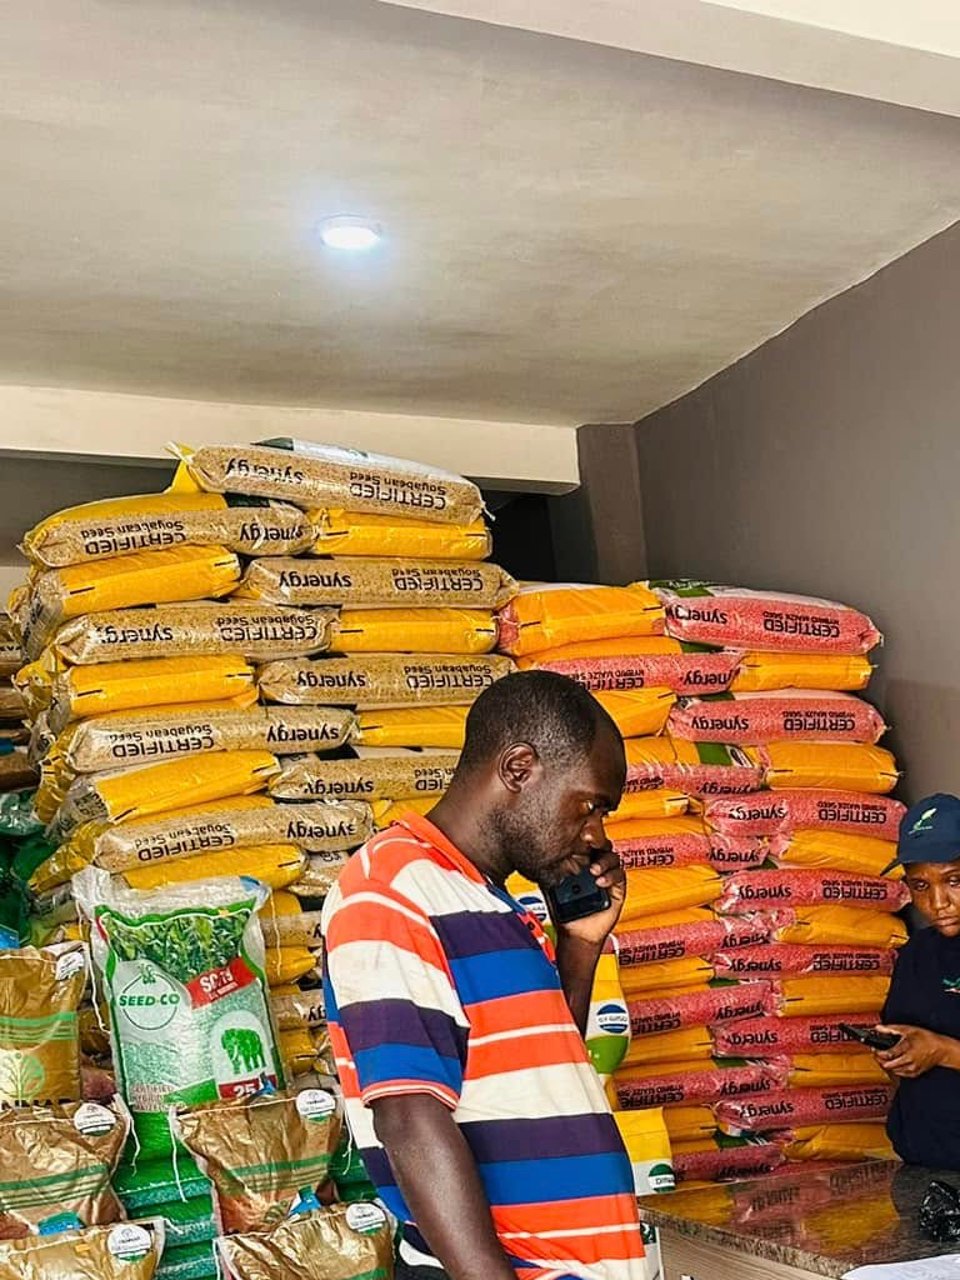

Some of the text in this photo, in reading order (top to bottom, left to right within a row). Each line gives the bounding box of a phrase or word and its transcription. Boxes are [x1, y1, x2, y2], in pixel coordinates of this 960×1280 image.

[349, 482, 446, 511] CERTIFIED
[85, 532, 187, 555] CERTIFIED
[279, 571, 352, 589] synergy
[395, 577, 483, 592] CERTIFIED
[220, 625, 318, 643] CERTIFIED
[763, 618, 841, 638] CERTIFIED
[297, 670, 366, 688] synergy
[406, 674, 493, 689] CERTIFIED
[587, 677, 645, 691] CERTIFI
[691, 716, 750, 731] synergy
[783, 718, 856, 731] CERTIFIED
[267, 724, 340, 743] synergy
[112, 735, 214, 758] CERTIFIED
[303, 779, 375, 796] synergy
[818, 808, 887, 824] CERTIFIED
[286, 819, 357, 840] synergy
[139, 833, 236, 862] CERTIFIED
[738, 884, 792, 901] synergy
[822, 886, 888, 900] CERTIFIED
[619, 947, 686, 966] CERTIFIE
[812, 959, 881, 971] CERTIFIED
[729, 959, 782, 973] synergy
[719, 1078, 772, 1096] synergy
[620, 1092, 685, 1108] CERTIFIE
[824, 1093, 889, 1110] CERTIFIED
